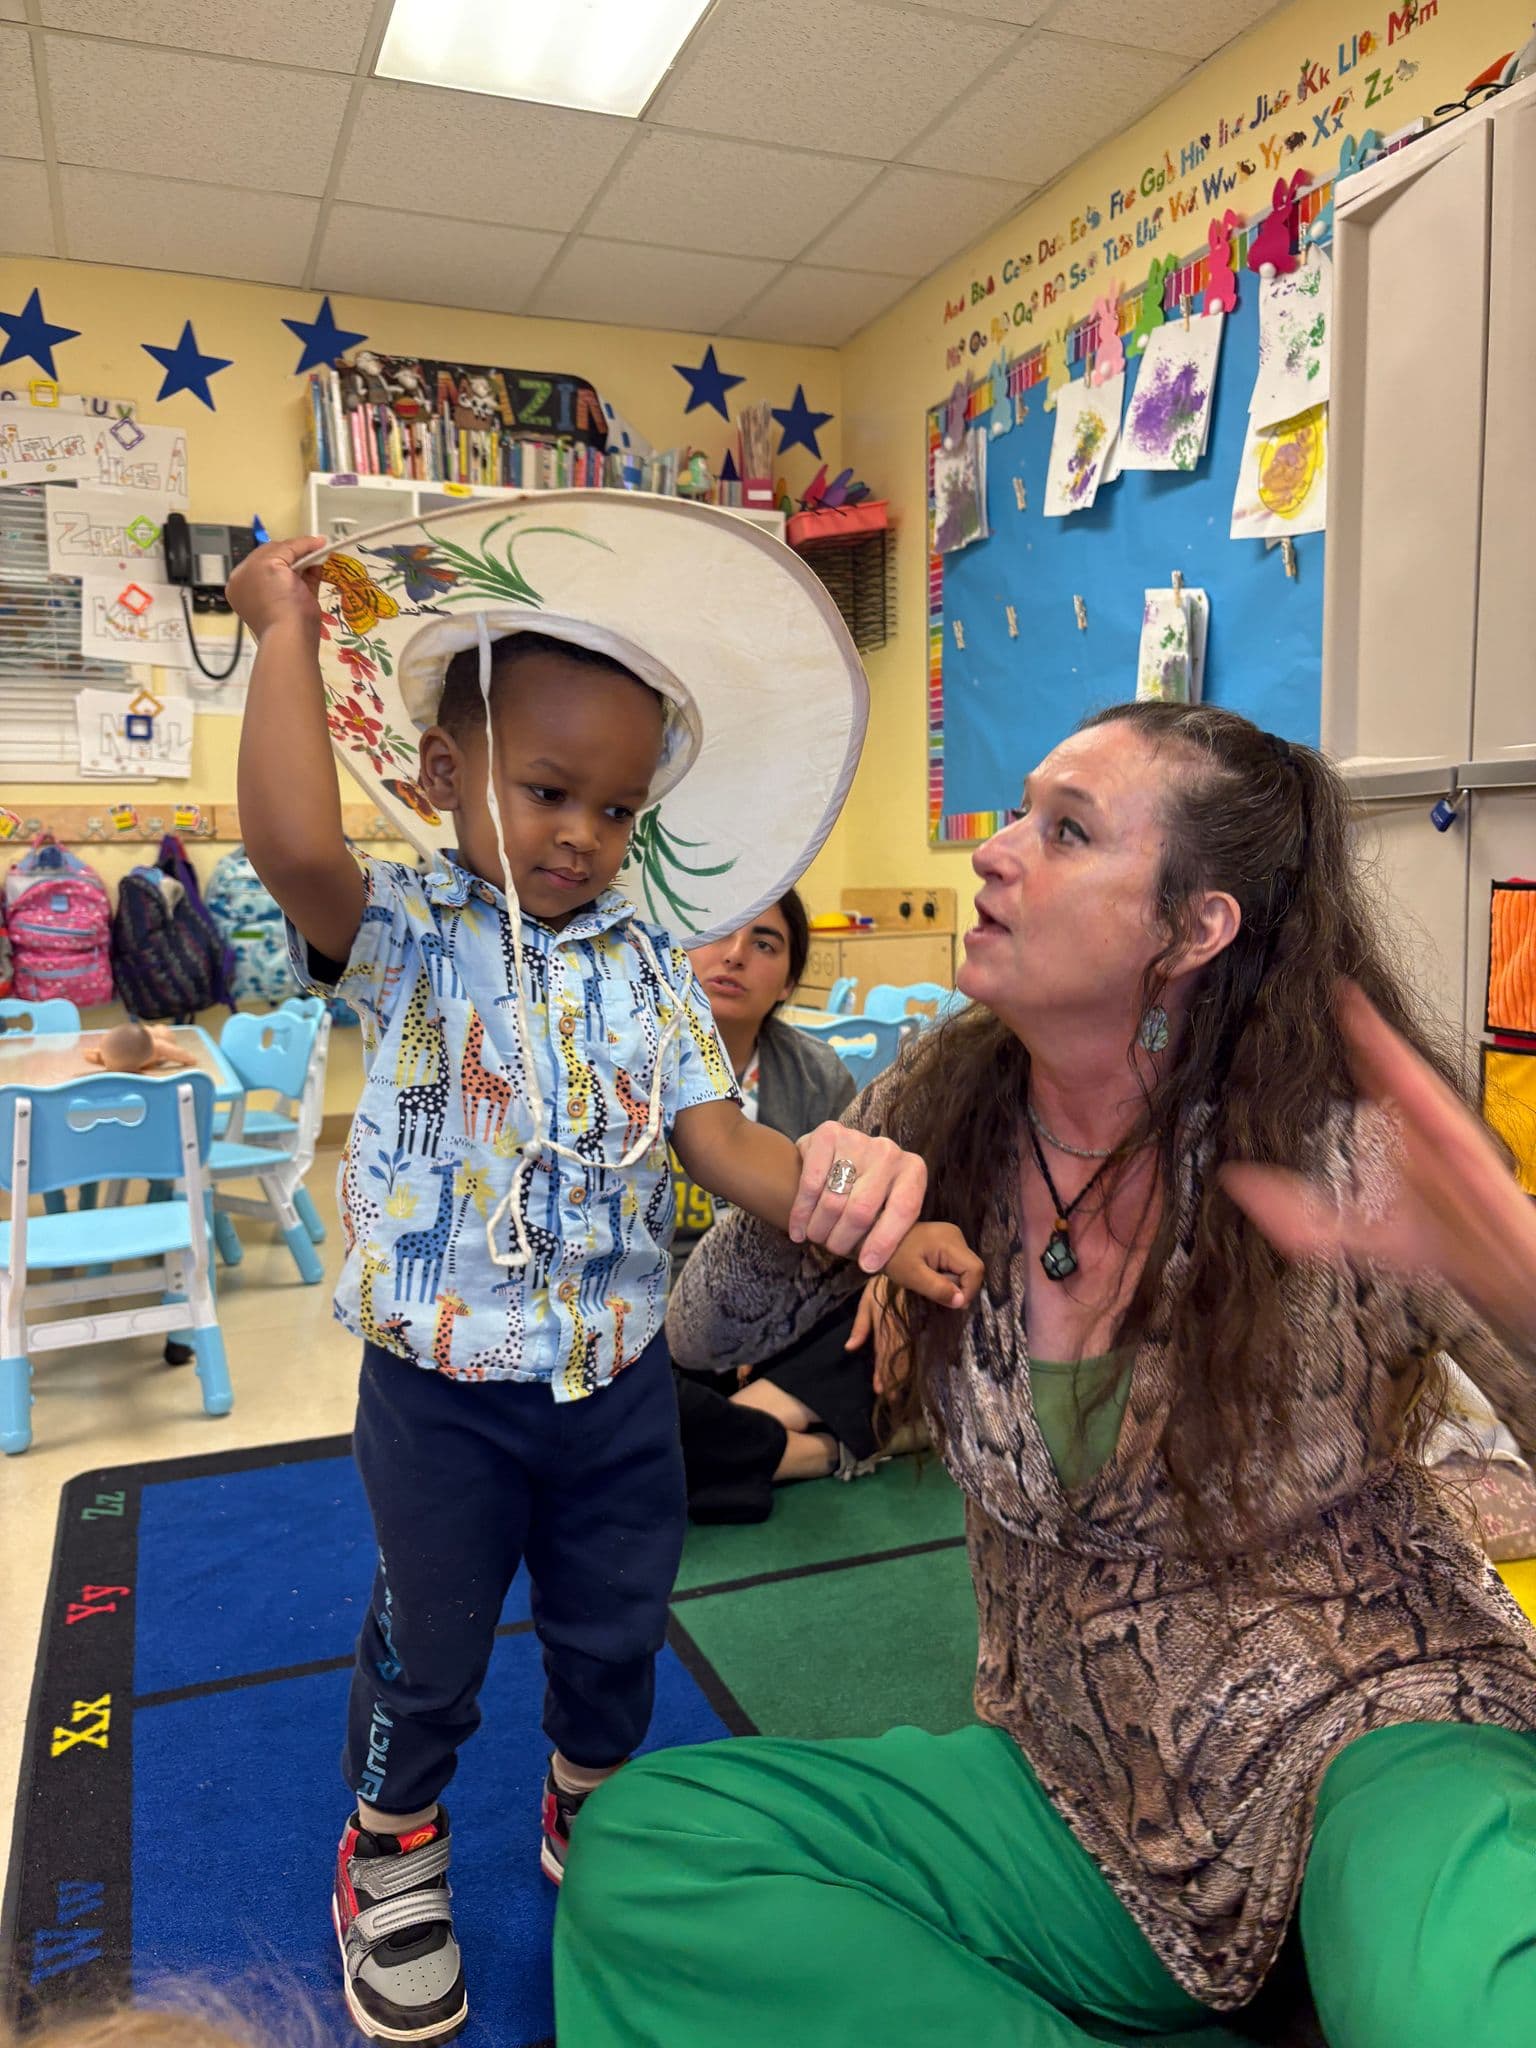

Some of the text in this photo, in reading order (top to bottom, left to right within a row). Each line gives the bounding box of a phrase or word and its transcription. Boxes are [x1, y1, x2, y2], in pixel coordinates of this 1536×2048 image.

[969, 330, 987, 355] Oo
[1013, 301, 1033, 327] Qq
[1069, 262, 1087, 290] Ss
[1103, 238, 1119, 266] Tt
[1136, 217, 1157, 248] Uu
[1169, 191, 1187, 223] Vv
[1202, 166, 1237, 206] Ww
[1259, 134, 1283, 170] Yy
[1312, 105, 1344, 148] Xx
[1364, 67, 1394, 109] Zz
[1002, 259, 1021, 284] Cc
[1038, 238, 1056, 264] Dd
[1070, 217, 1087, 244] Ee
[1140, 167, 1165, 197] Gg
[1180, 141, 1205, 177] Hh
[1249, 94, 1268, 129] Jj
[1303, 62, 1330, 101] Kk
[1338, 35, 1358, 76] Ll
[1388, 0, 1438, 46] Mm
[93, 398, 108, 415] U
[29, 1489, 131, 1985] Ww Xx Yy Zz
